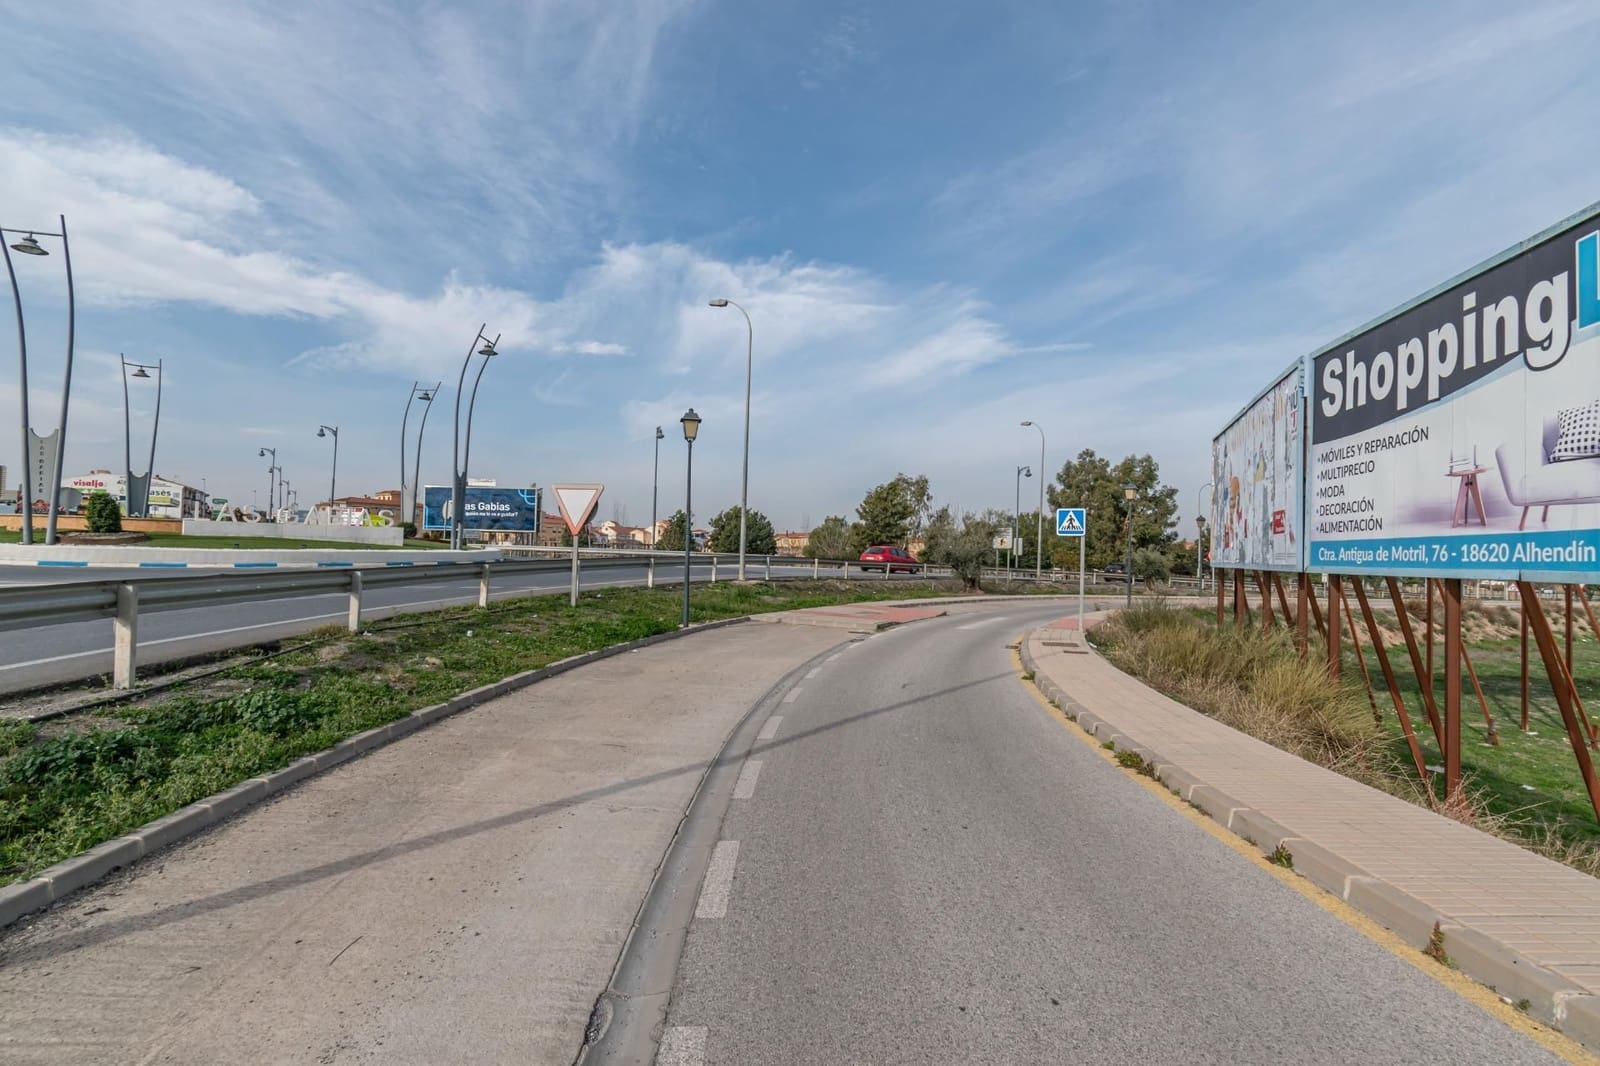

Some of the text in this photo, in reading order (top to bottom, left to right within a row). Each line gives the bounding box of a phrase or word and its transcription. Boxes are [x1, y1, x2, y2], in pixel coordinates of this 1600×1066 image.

[1321, 425, 1429, 464] MÓVILES Y REPARACIÓN
[1320, 460, 1375, 481] MULTIPRECIO
[1320, 484, 1345, 499] MODA
[191, 501, 261, 523] LAS
[464, 502, 511, 511] as Gabias
[1320, 496, 1374, 517] DECORACIÓN
[1319, 515, 1383, 534] ALIMENTACIÓN
[1318, 547, 1337, 561] Ctra.
[1339, 547, 1374, 564] Antigua
[1375, 546, 1389, 561] de
[1391, 545, 1429, 564] Motril,
[1431, 544, 1448, 562] 76
[1460, 543, 1509, 563] 18620
[1512, 540, 1597, 563] Alhendín
